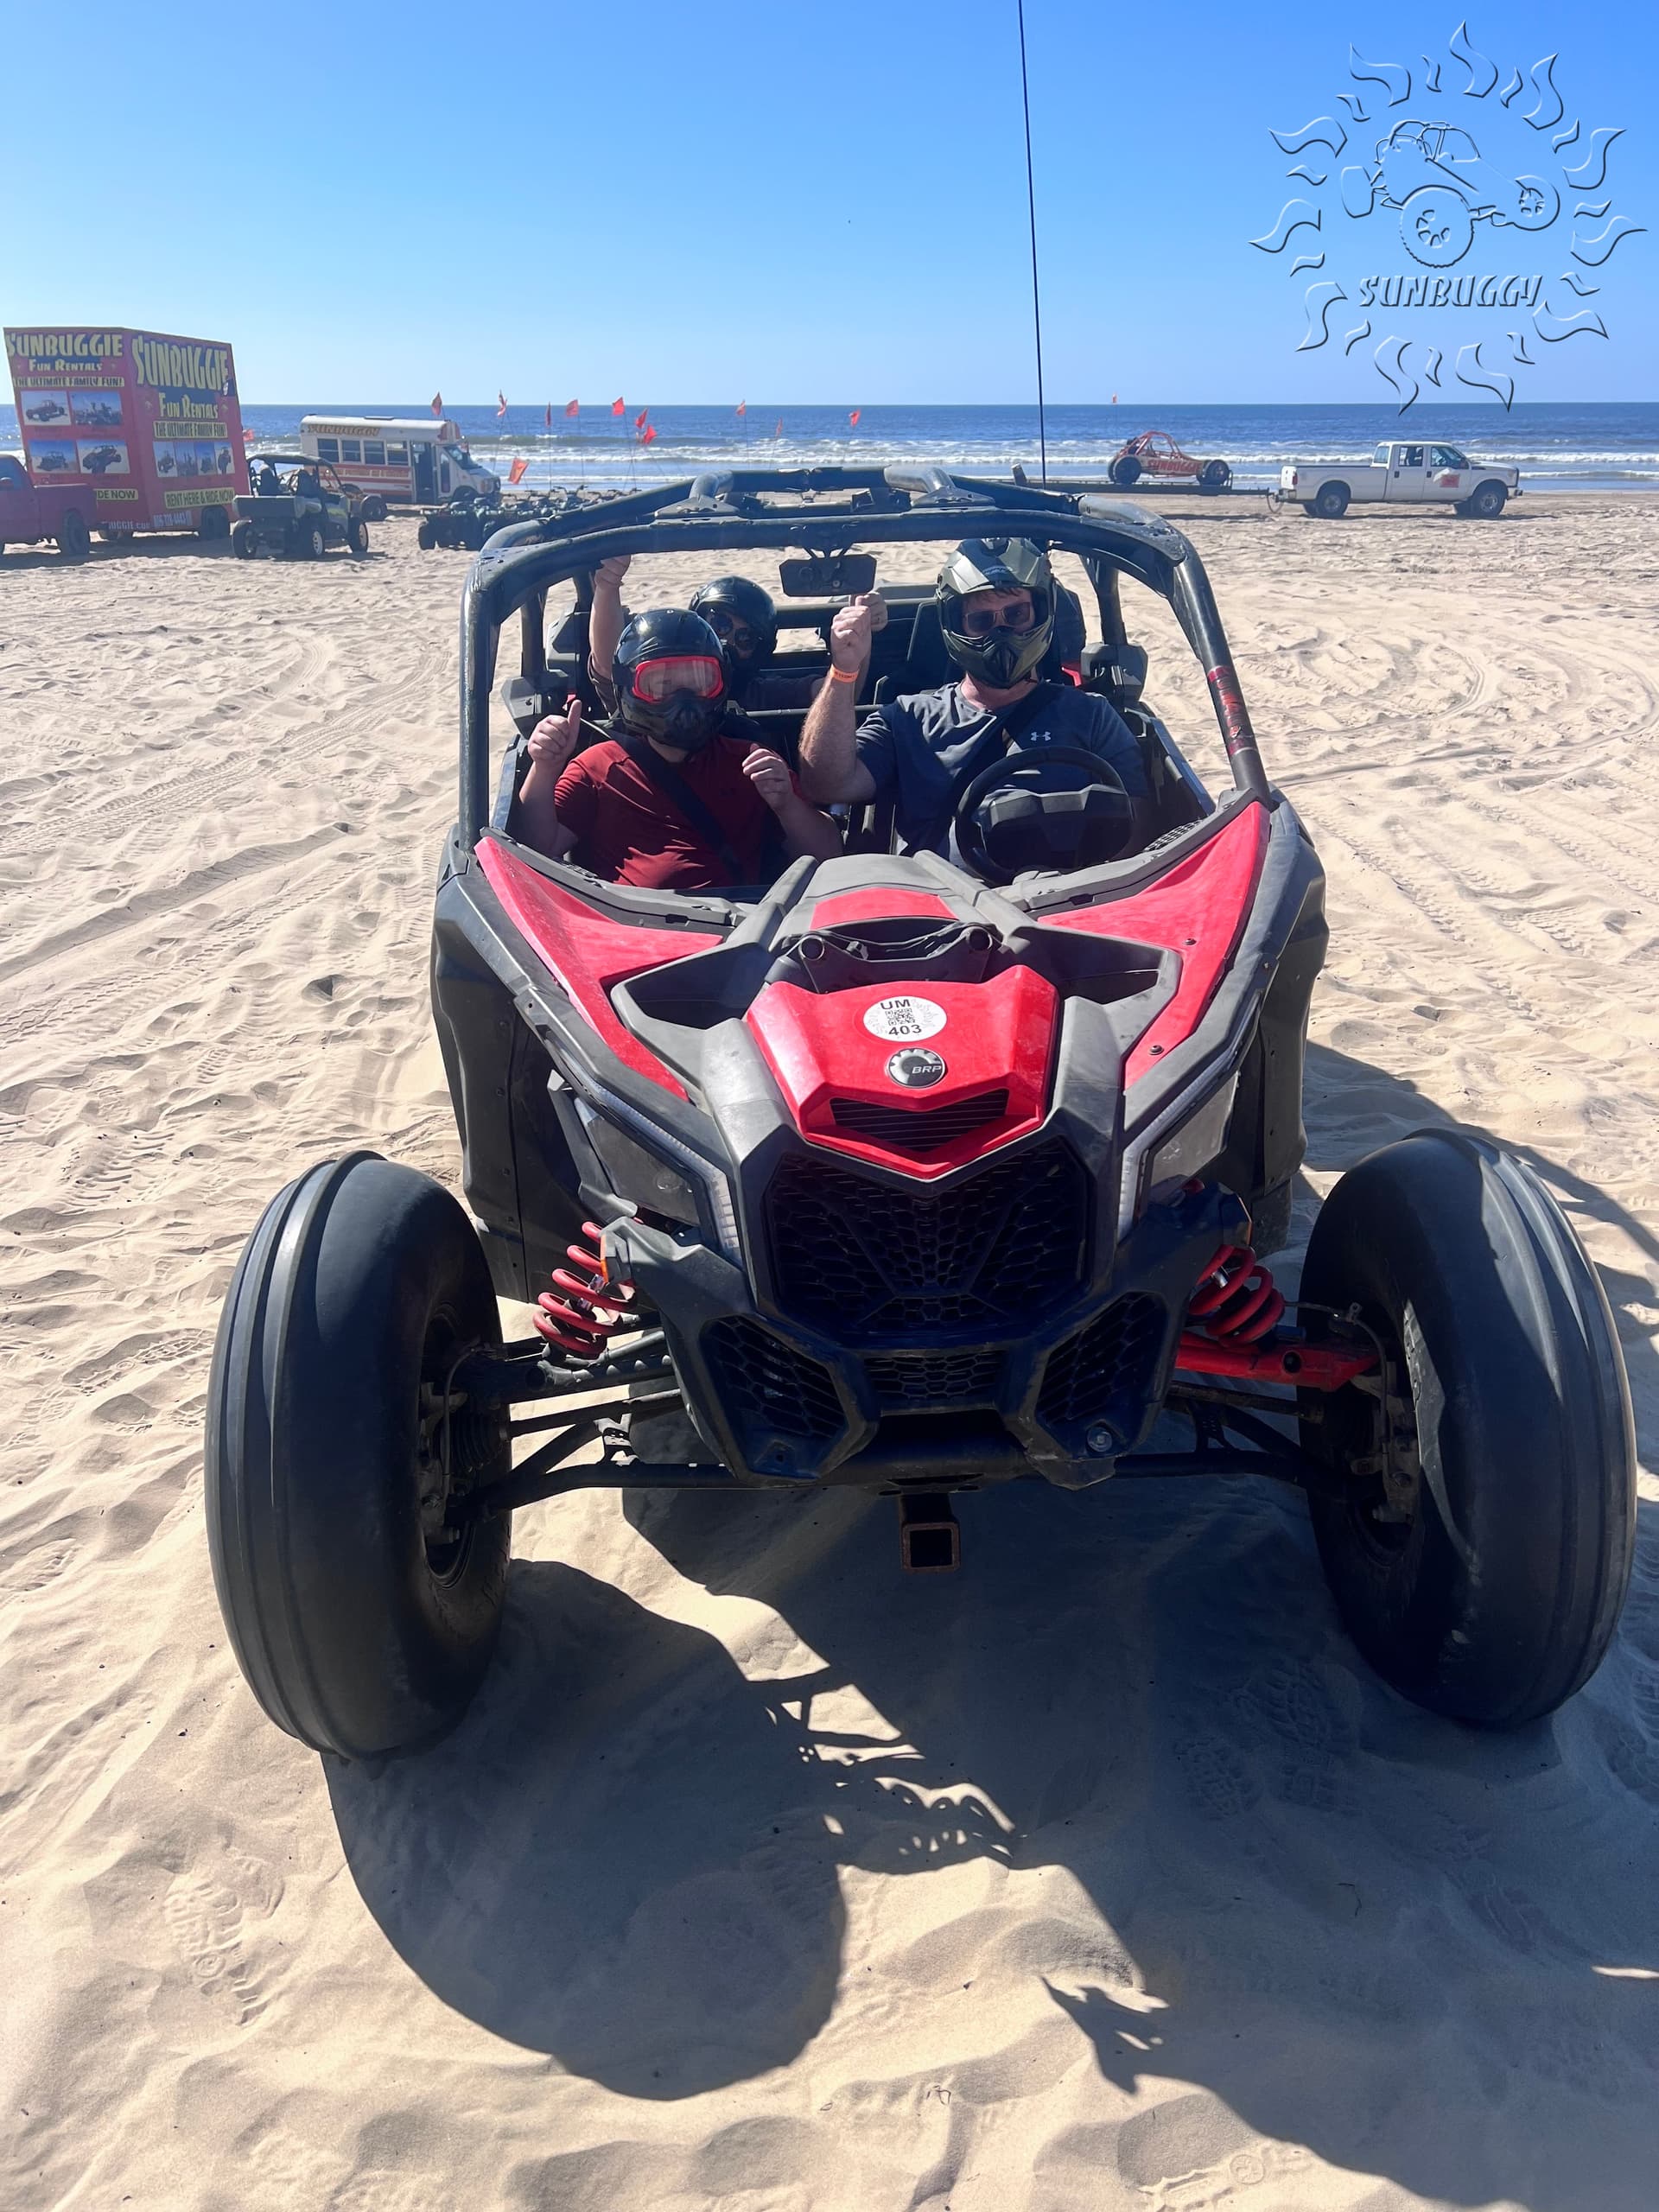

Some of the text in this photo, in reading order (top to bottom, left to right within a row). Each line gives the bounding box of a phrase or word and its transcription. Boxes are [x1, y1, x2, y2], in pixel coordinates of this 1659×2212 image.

[5, 332, 124, 356] SUNBUGGIE
[131, 335, 229, 391] SUNBUGGIE
[111, 490, 136, 499] NOW
[880, 999, 911, 1010] UM
[888, 1024, 922, 1036] 403
[912, 1065, 943, 1074] BRP
